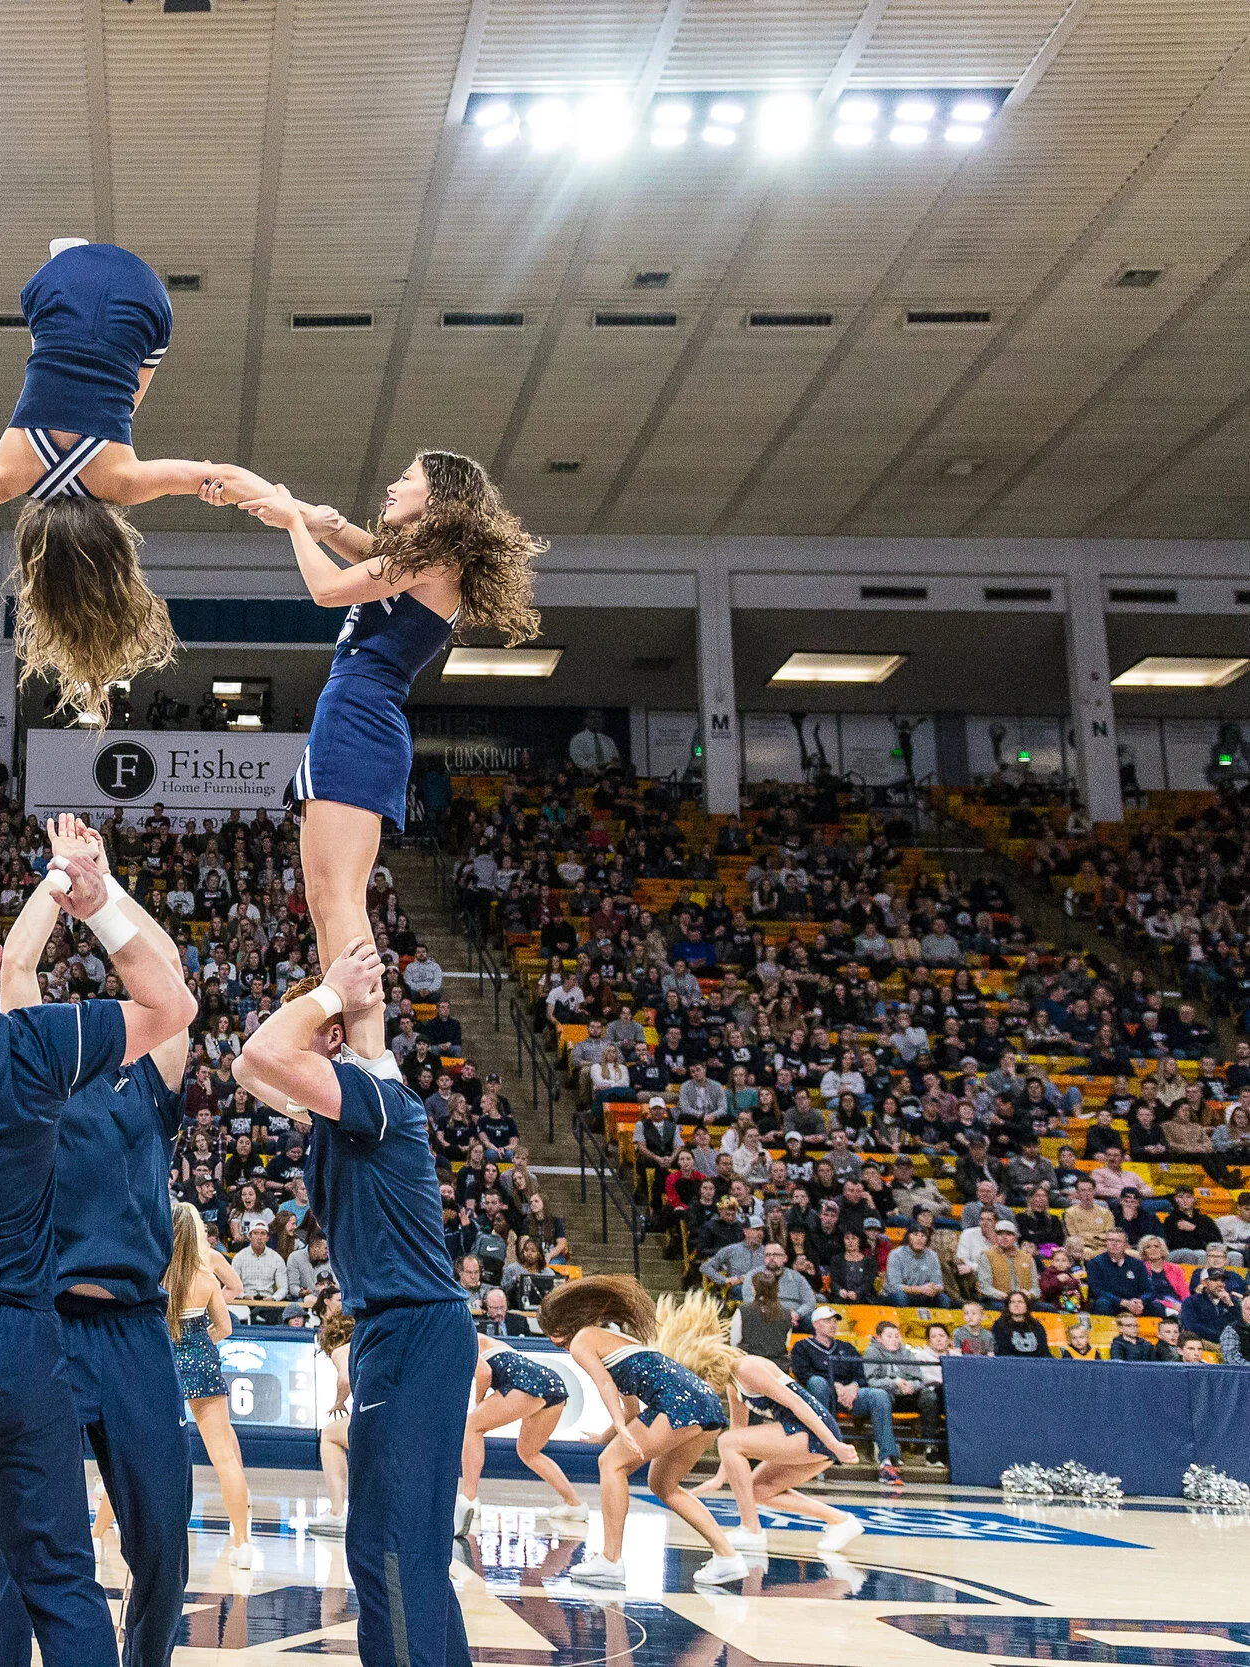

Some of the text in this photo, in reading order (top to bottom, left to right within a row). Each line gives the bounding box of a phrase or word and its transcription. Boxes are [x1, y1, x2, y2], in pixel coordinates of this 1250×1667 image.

[711, 714, 729, 729] M
[1091, 720, 1108, 737] N
[111, 753, 139, 788] F
[167, 748, 270, 779] Fisher
[162, 781, 276, 797] Home Furnishings
[230, 1377, 255, 1416] 6
